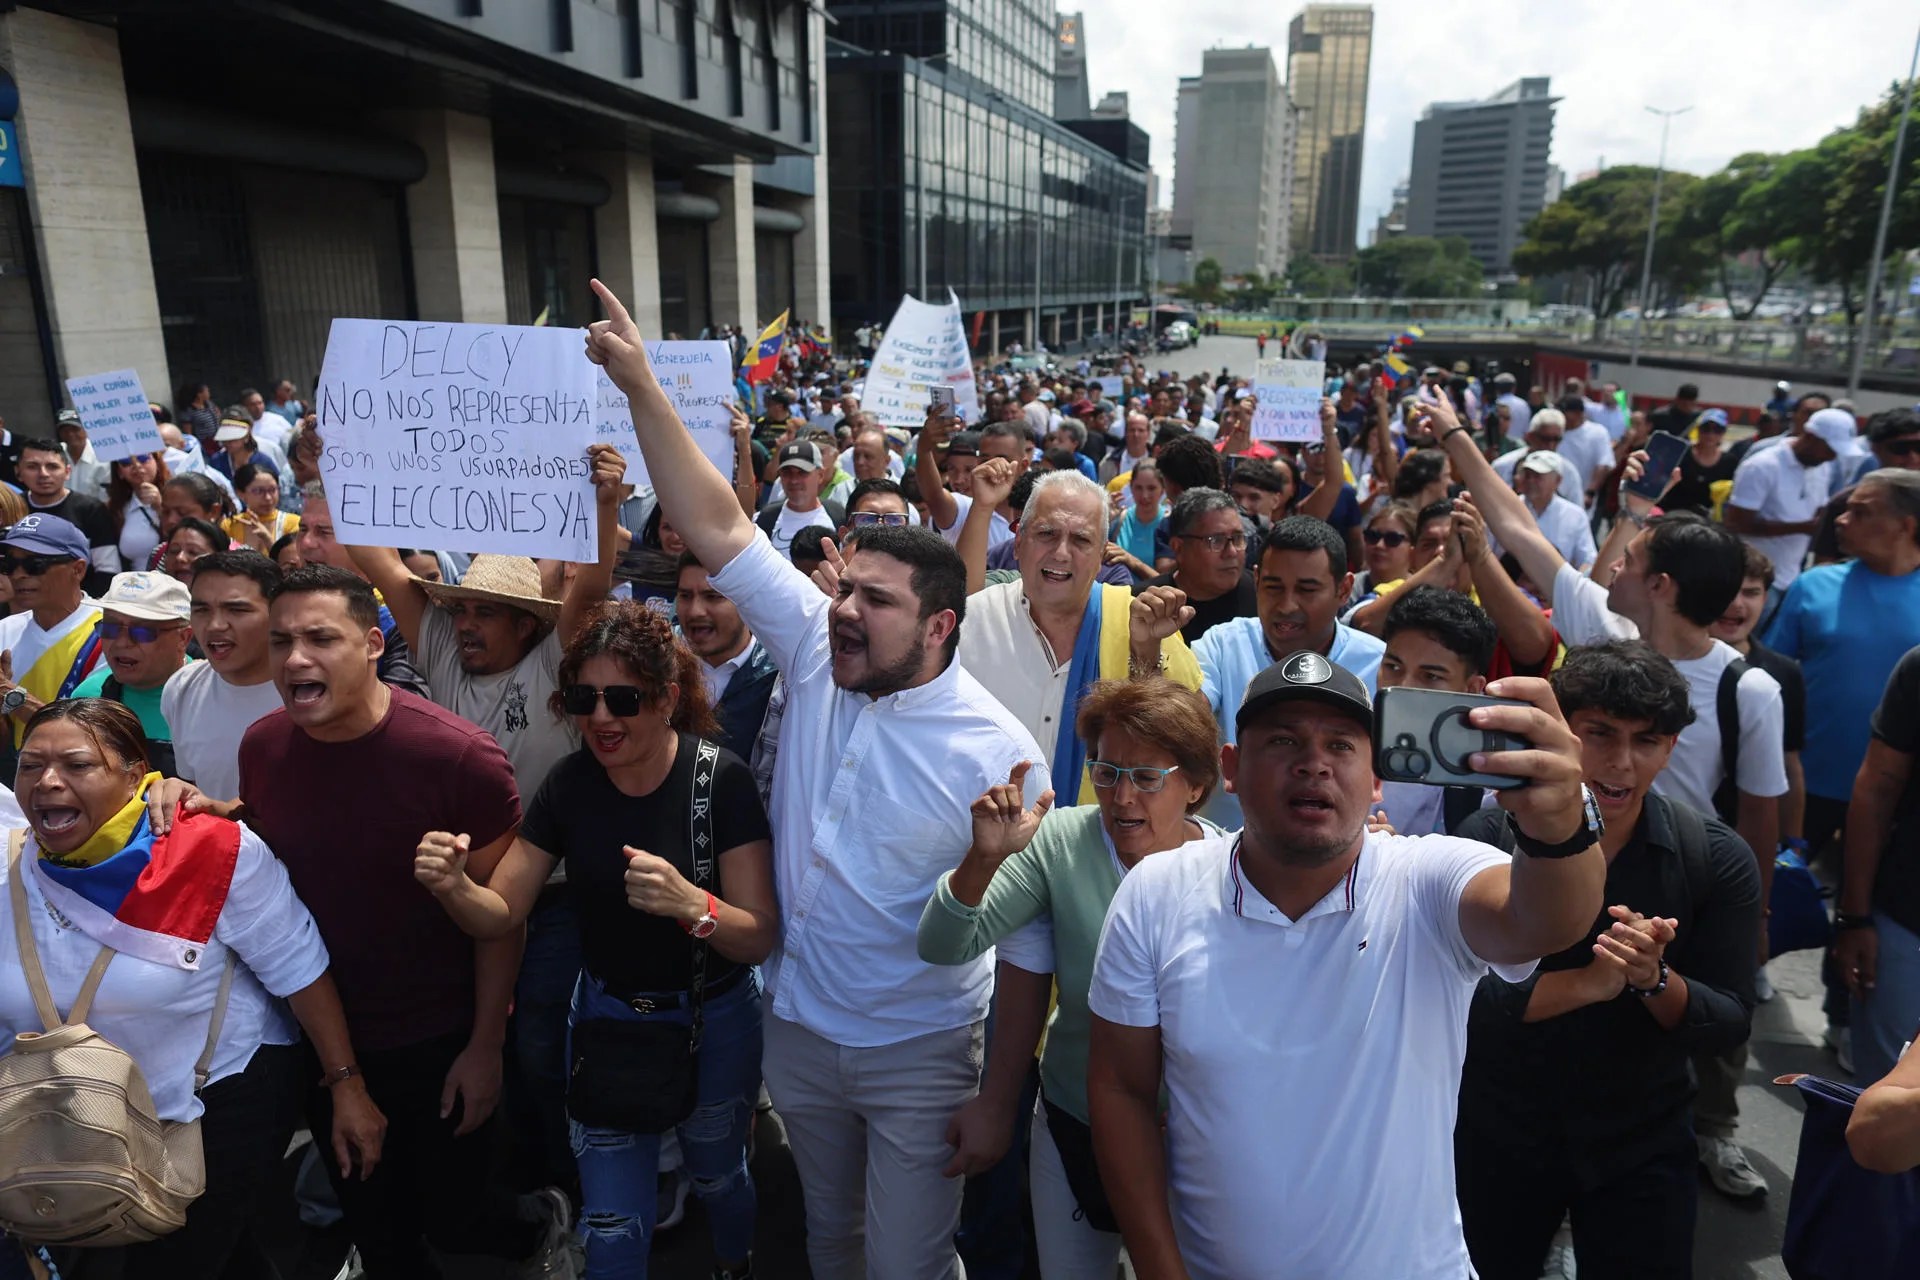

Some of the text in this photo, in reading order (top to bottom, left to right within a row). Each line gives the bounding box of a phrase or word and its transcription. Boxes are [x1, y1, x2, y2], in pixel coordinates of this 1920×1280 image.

[380, 325, 523, 386] DELCY
[387, 388, 435, 421] NOS
[448, 384, 590, 426] REPRESENTA
[390, 450, 442, 472] UNOS
[404, 427, 509, 454] TODOS
[341, 484, 589, 540] ELECCIONES YA
